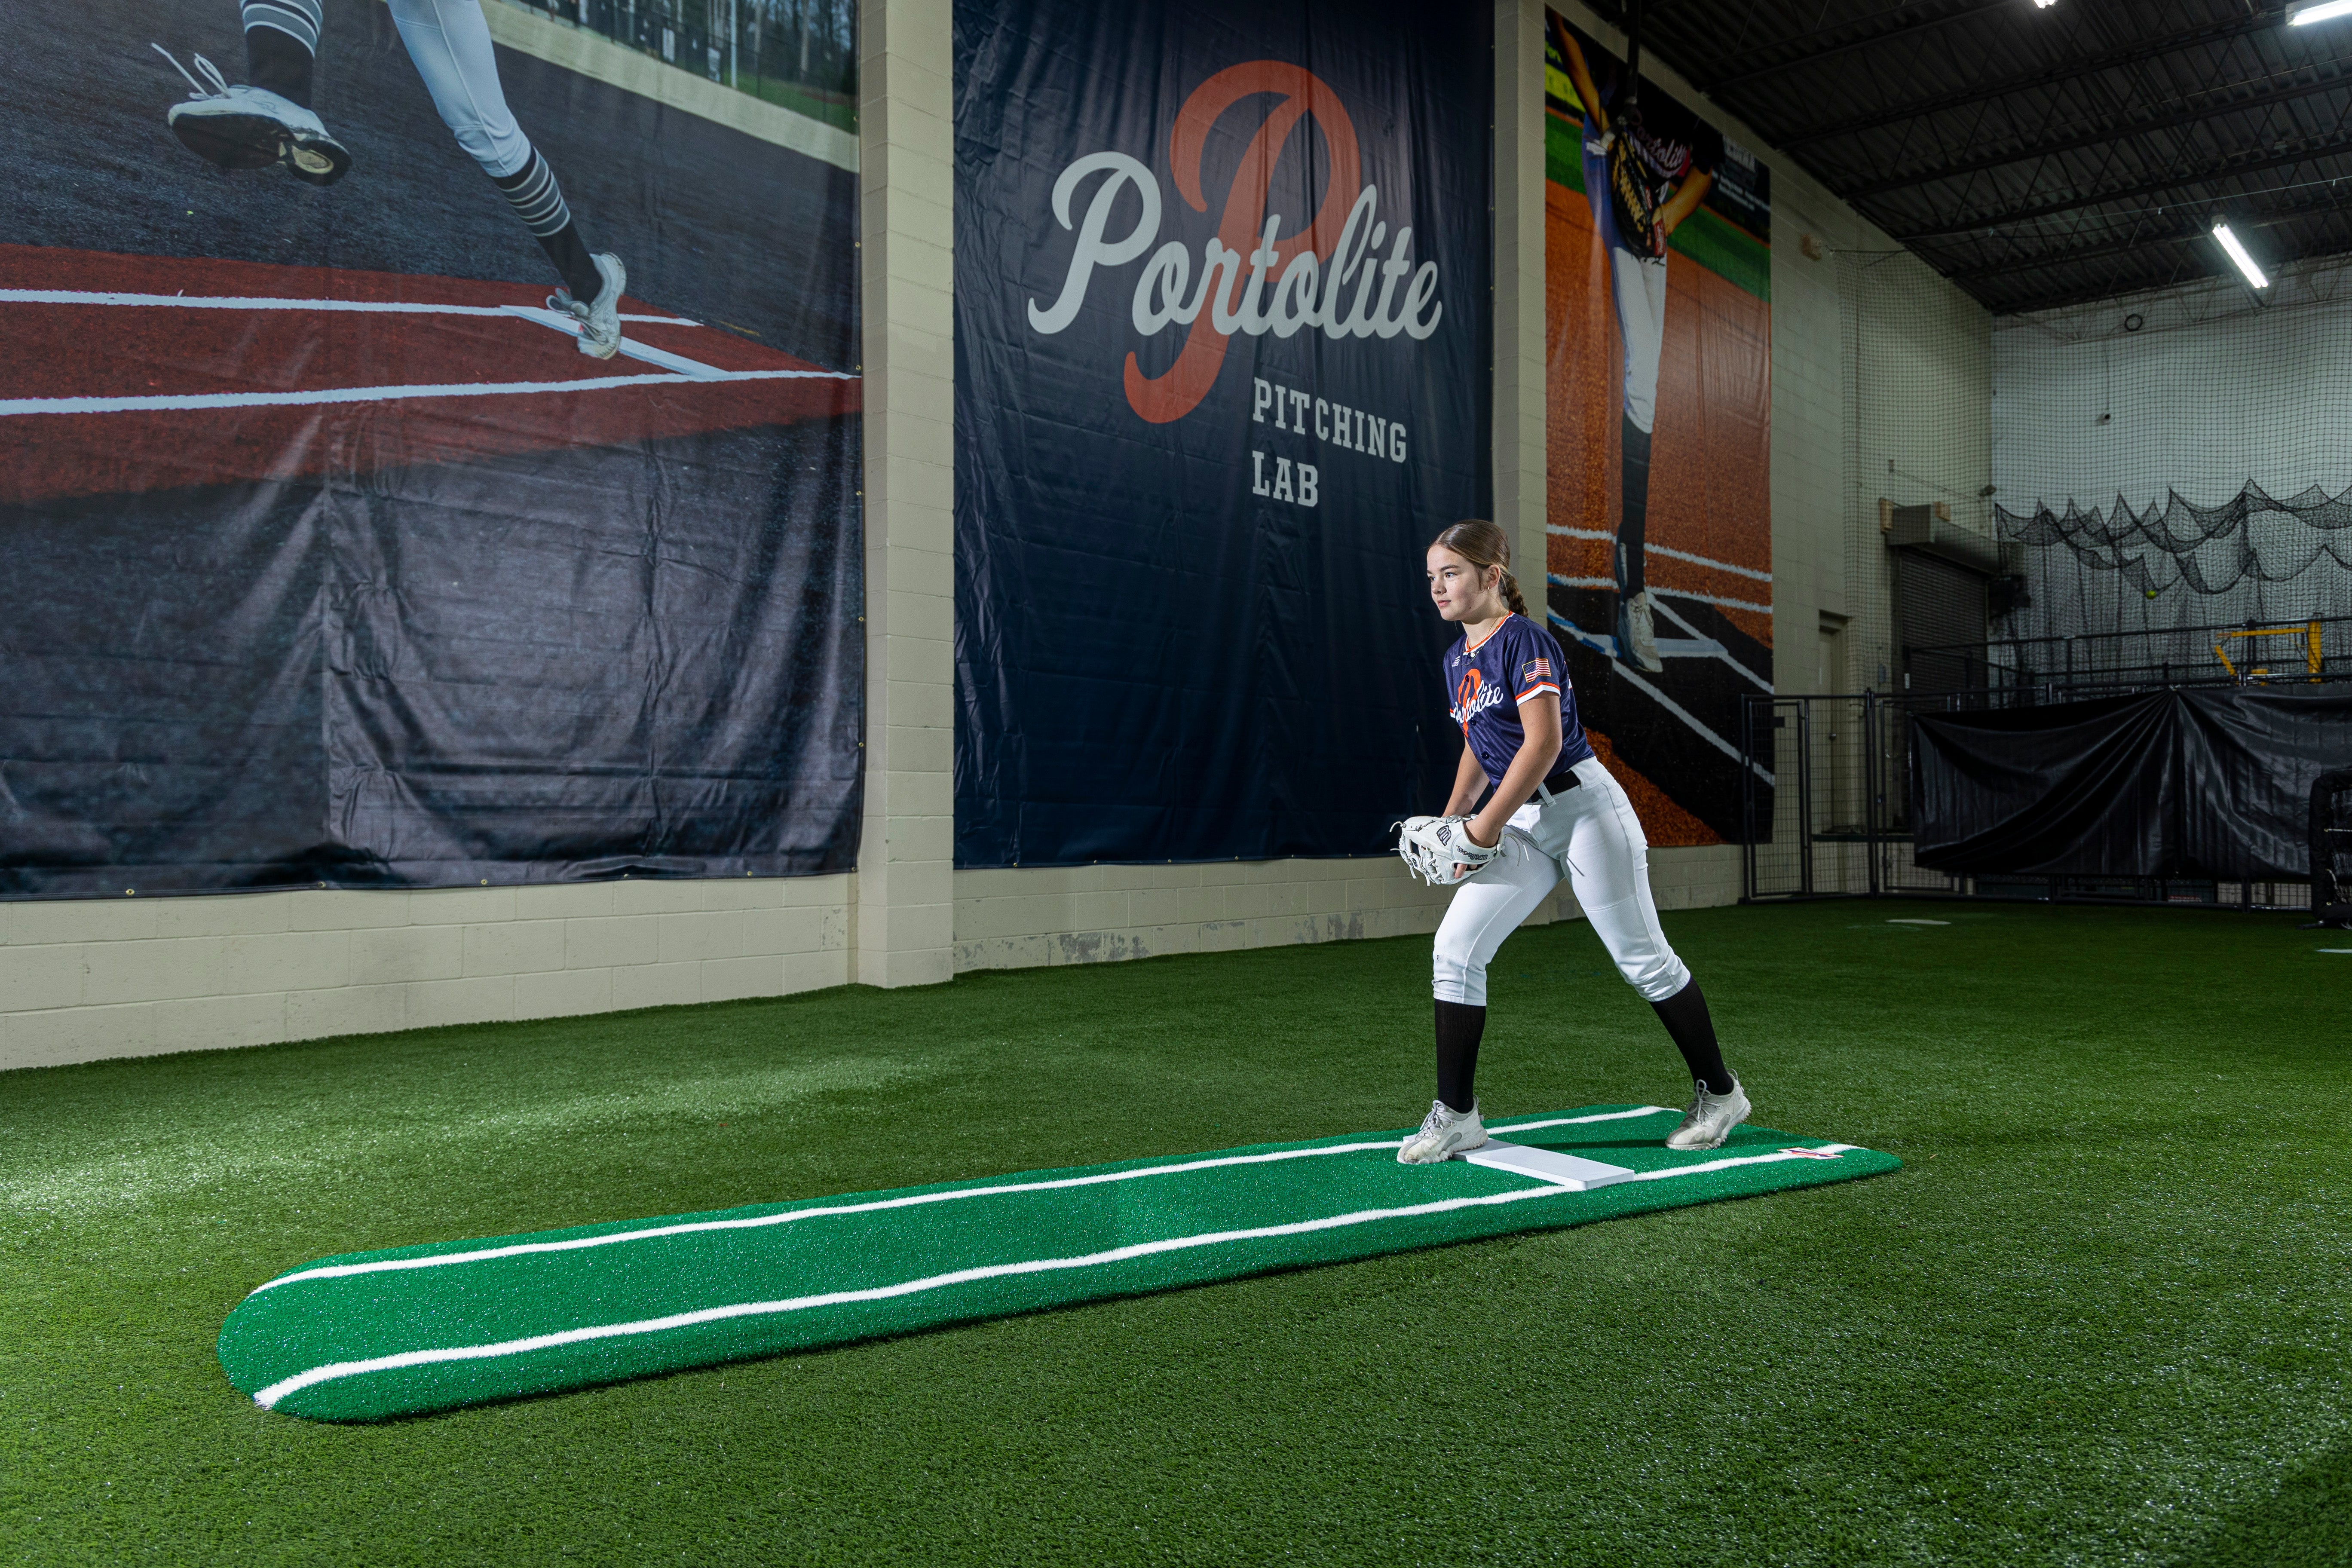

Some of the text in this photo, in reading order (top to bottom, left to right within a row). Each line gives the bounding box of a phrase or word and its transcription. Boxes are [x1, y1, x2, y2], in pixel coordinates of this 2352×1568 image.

[1028, 151, 1442, 339] Portolite
[1253, 377, 1406, 463] PITCHING
[1252, 450, 1318, 507] LAB
